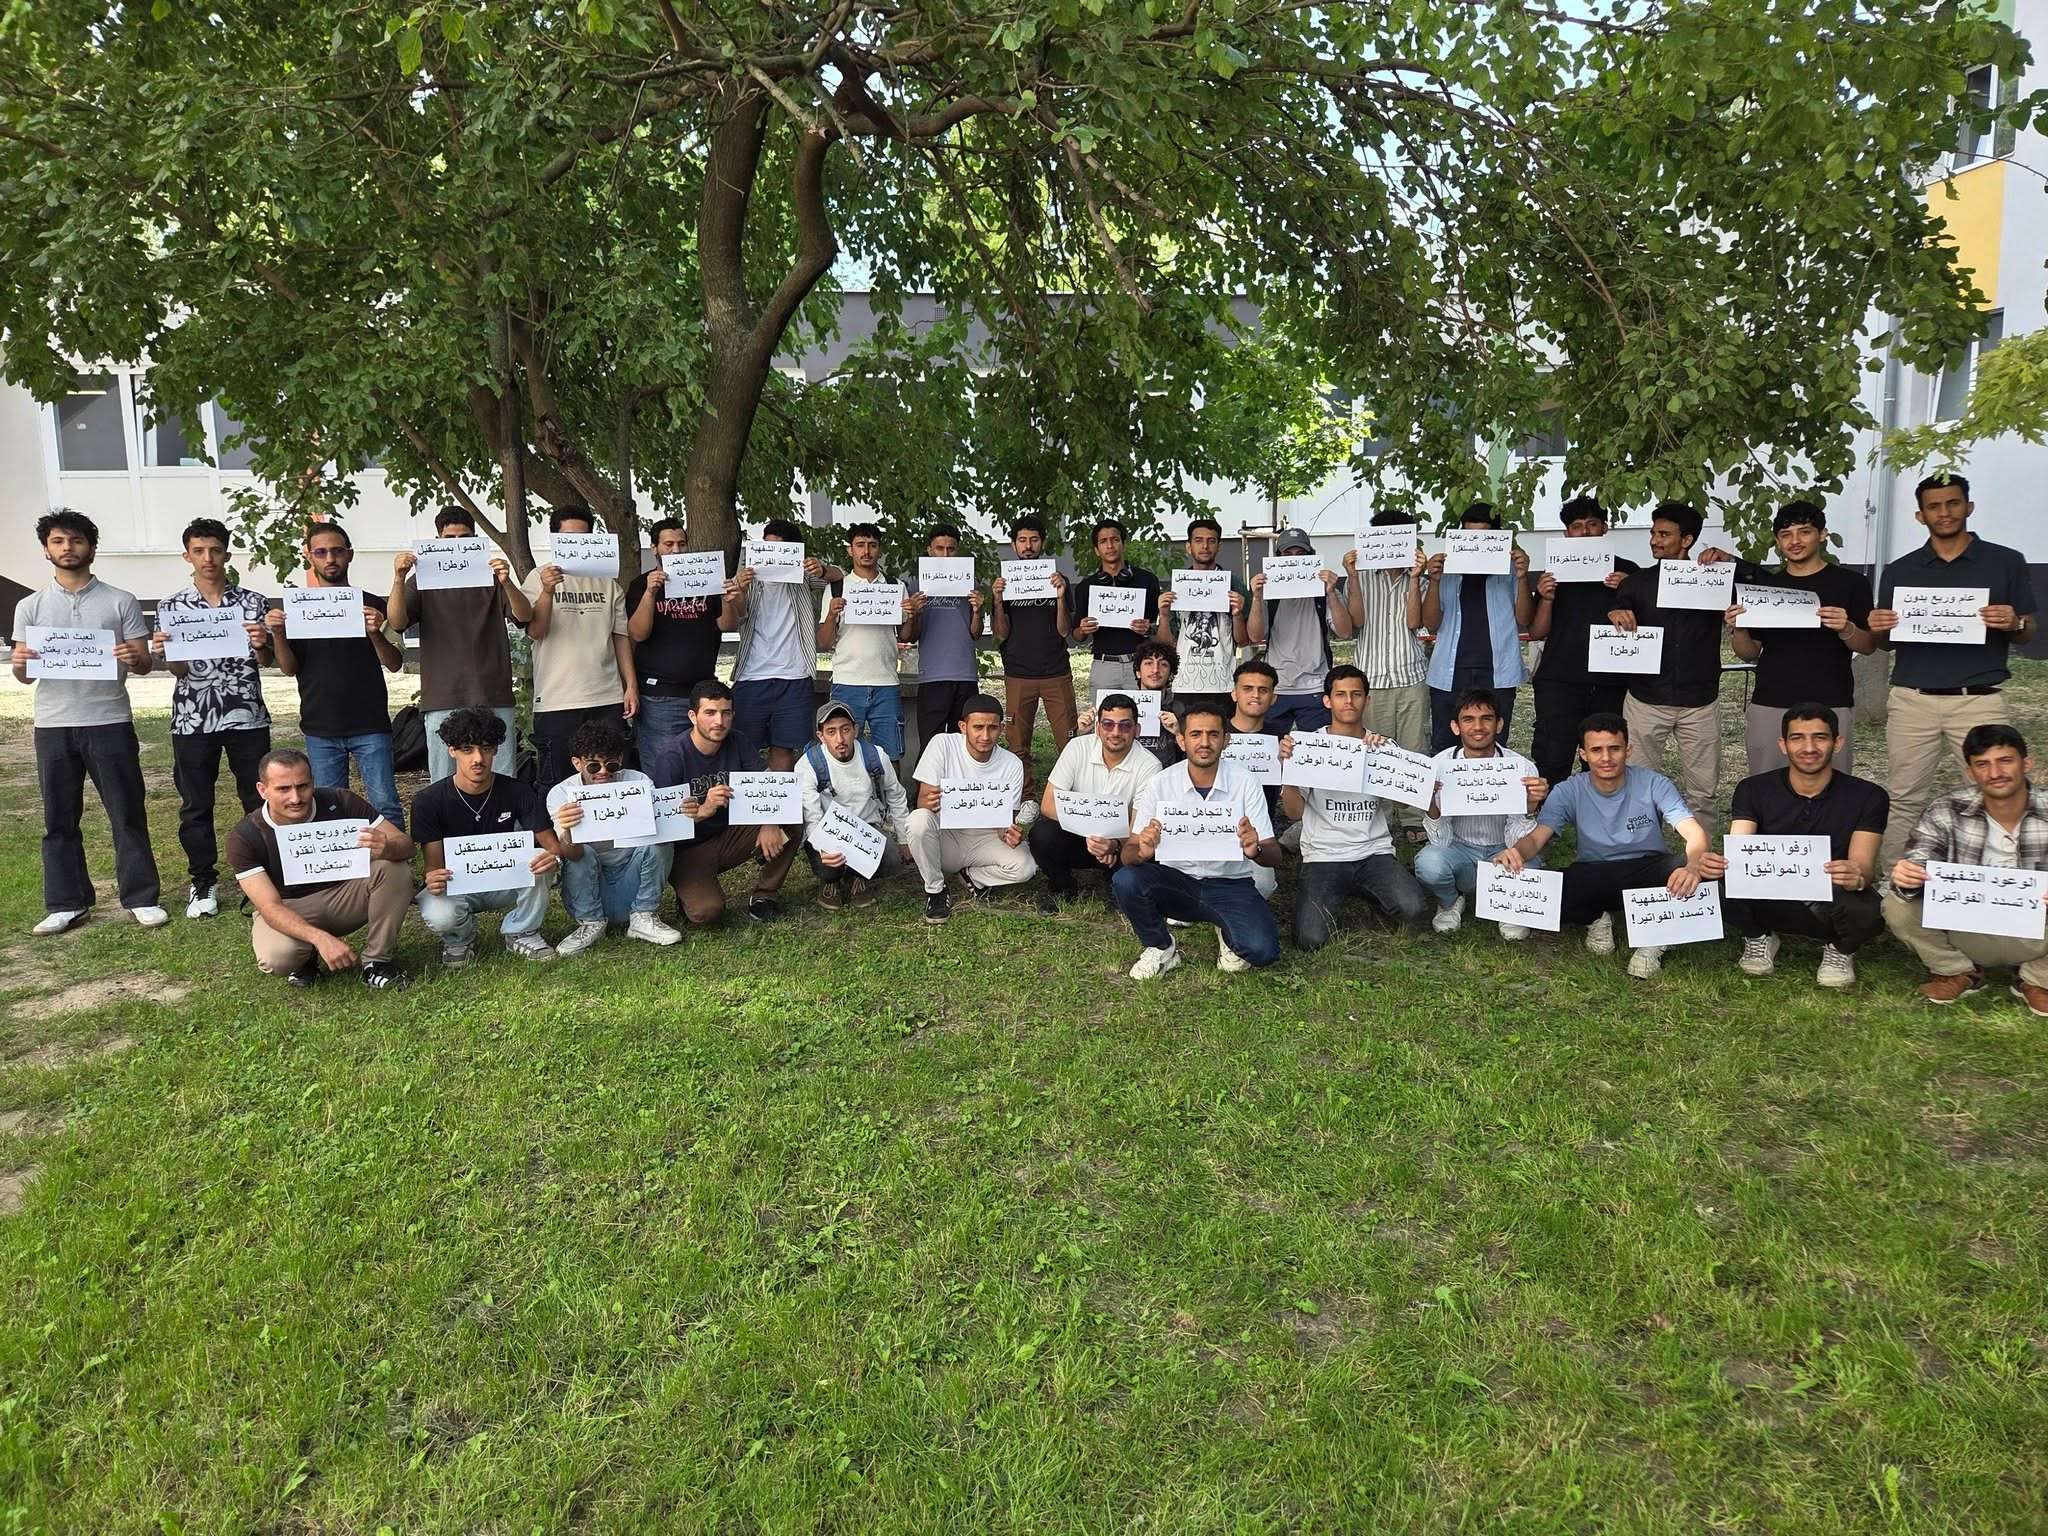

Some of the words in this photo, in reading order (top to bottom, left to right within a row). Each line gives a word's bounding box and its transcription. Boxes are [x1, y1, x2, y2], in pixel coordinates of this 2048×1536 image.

[1604, 554, 1610, 562] 5
[1610, 645, 1640, 657] الوطن!
[1306, 739, 1333, 749] الطالب
[1336, 740, 1362, 754] كرامة
[1327, 756, 1353, 770] كرامة
[943, 785, 956, 794] من
[959, 783, 985, 793] الطالب
[987, 782, 1010, 793] كرامة
[981, 797, 1004, 808] كرامة
[594, 806, 628, 821] الوطن!
[1163, 807, 1189, 816] معاناة
[1226, 808, 1233, 817] لا
[288, 832, 311, 841] بدون
[316, 829, 340, 840] وربع
[342, 825, 358, 837] عام
[454, 842, 492, 856] مستقبل
[1741, 842, 1776, 856] بالعهد
[466, 859, 516, 874] المبتعثين!
[1745, 861, 1810, 878] والمواثيق!
[1490, 898, 1512, 911] اليمن!
[1631, 892, 1672, 907] الشفهية
[2028, 898, 2039, 909] لا
[1515, 903, 1545, 915] مستقبل
[1679, 907, 1704, 919] تسدد
[1706, 905, 1715, 916] لا
